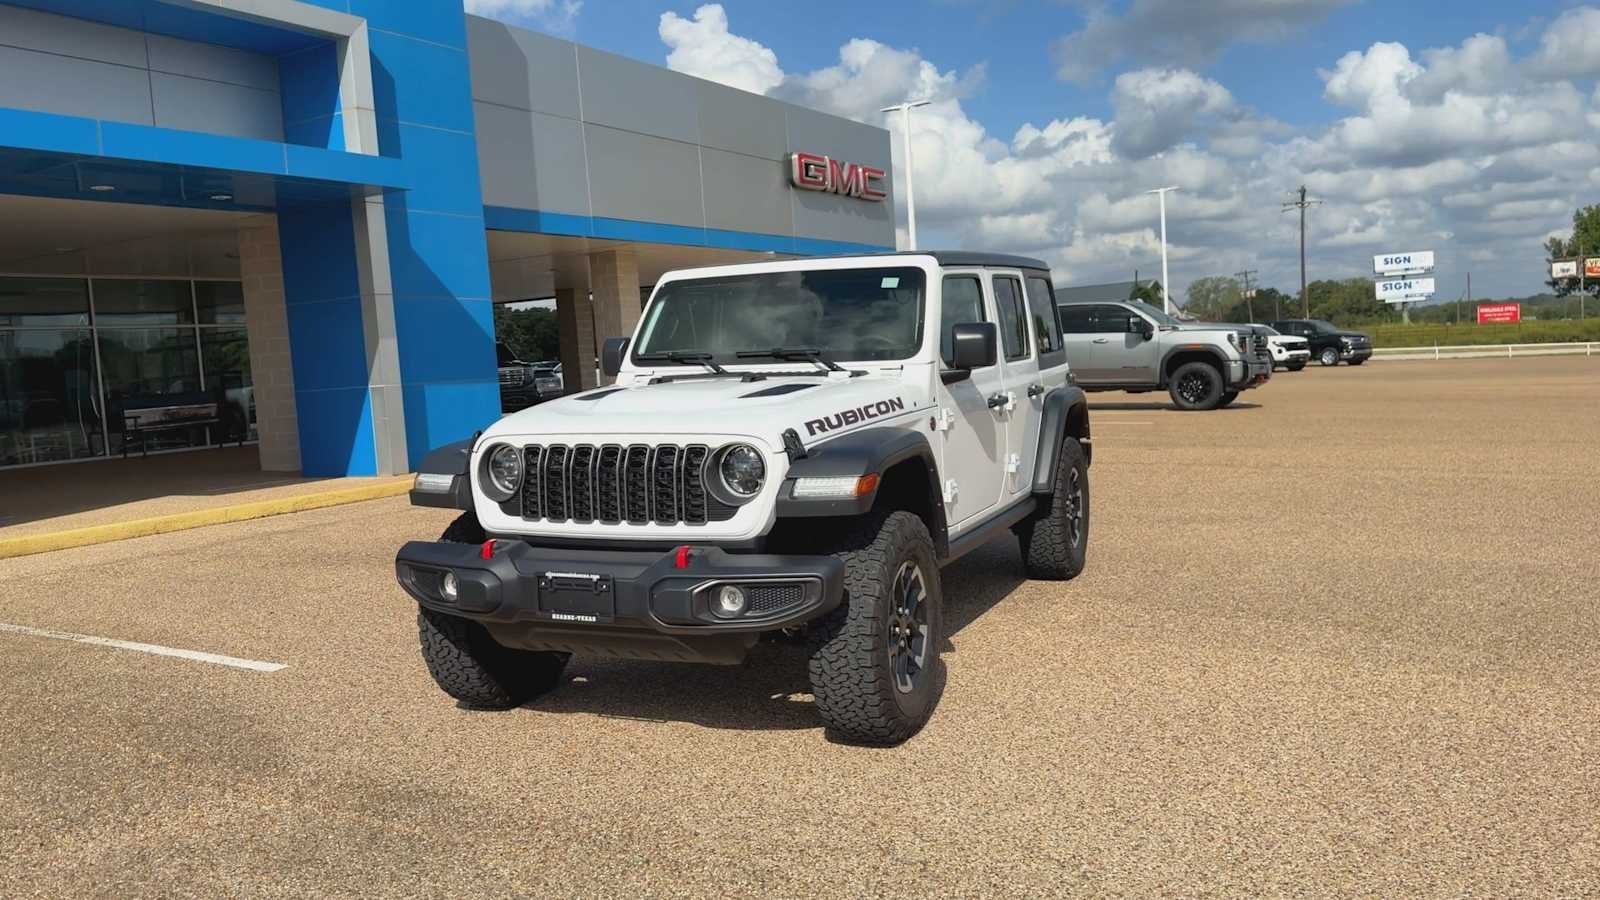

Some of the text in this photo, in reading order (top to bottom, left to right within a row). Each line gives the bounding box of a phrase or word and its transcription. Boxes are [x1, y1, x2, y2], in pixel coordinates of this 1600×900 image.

[792, 153, 886, 201] GMC
[1383, 256, 1411, 265] SIGN
[1382, 281, 1412, 292] SIGN
[804, 396, 904, 437] RUBICON
